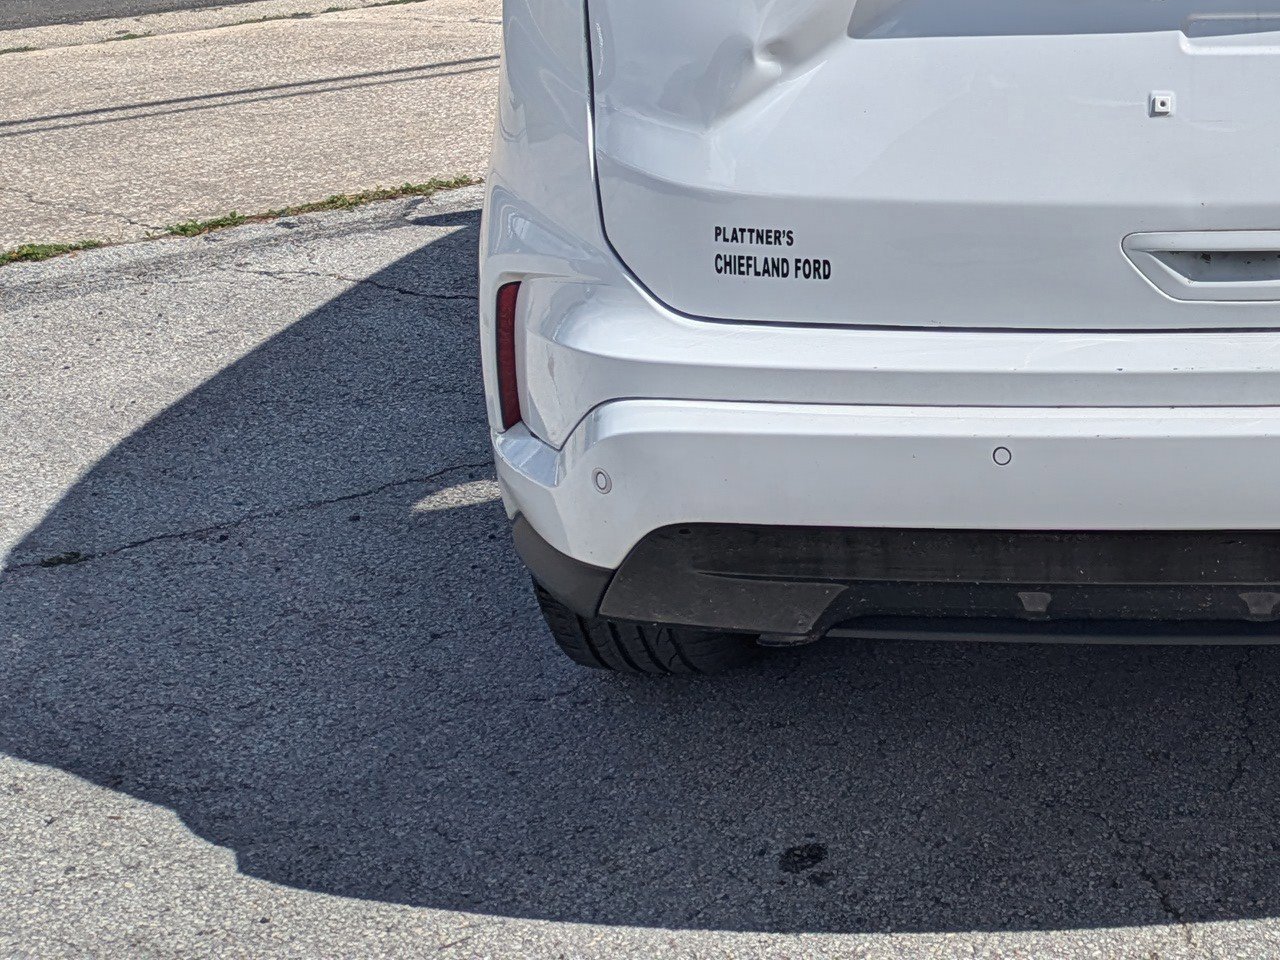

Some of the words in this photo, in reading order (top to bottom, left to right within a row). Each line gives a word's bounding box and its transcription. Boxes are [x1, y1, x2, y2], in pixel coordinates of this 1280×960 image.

[714, 226, 794, 246] PLATTNER'S
[714, 253, 790, 278] CHIEFLAND
[794, 258, 832, 280] FORD
